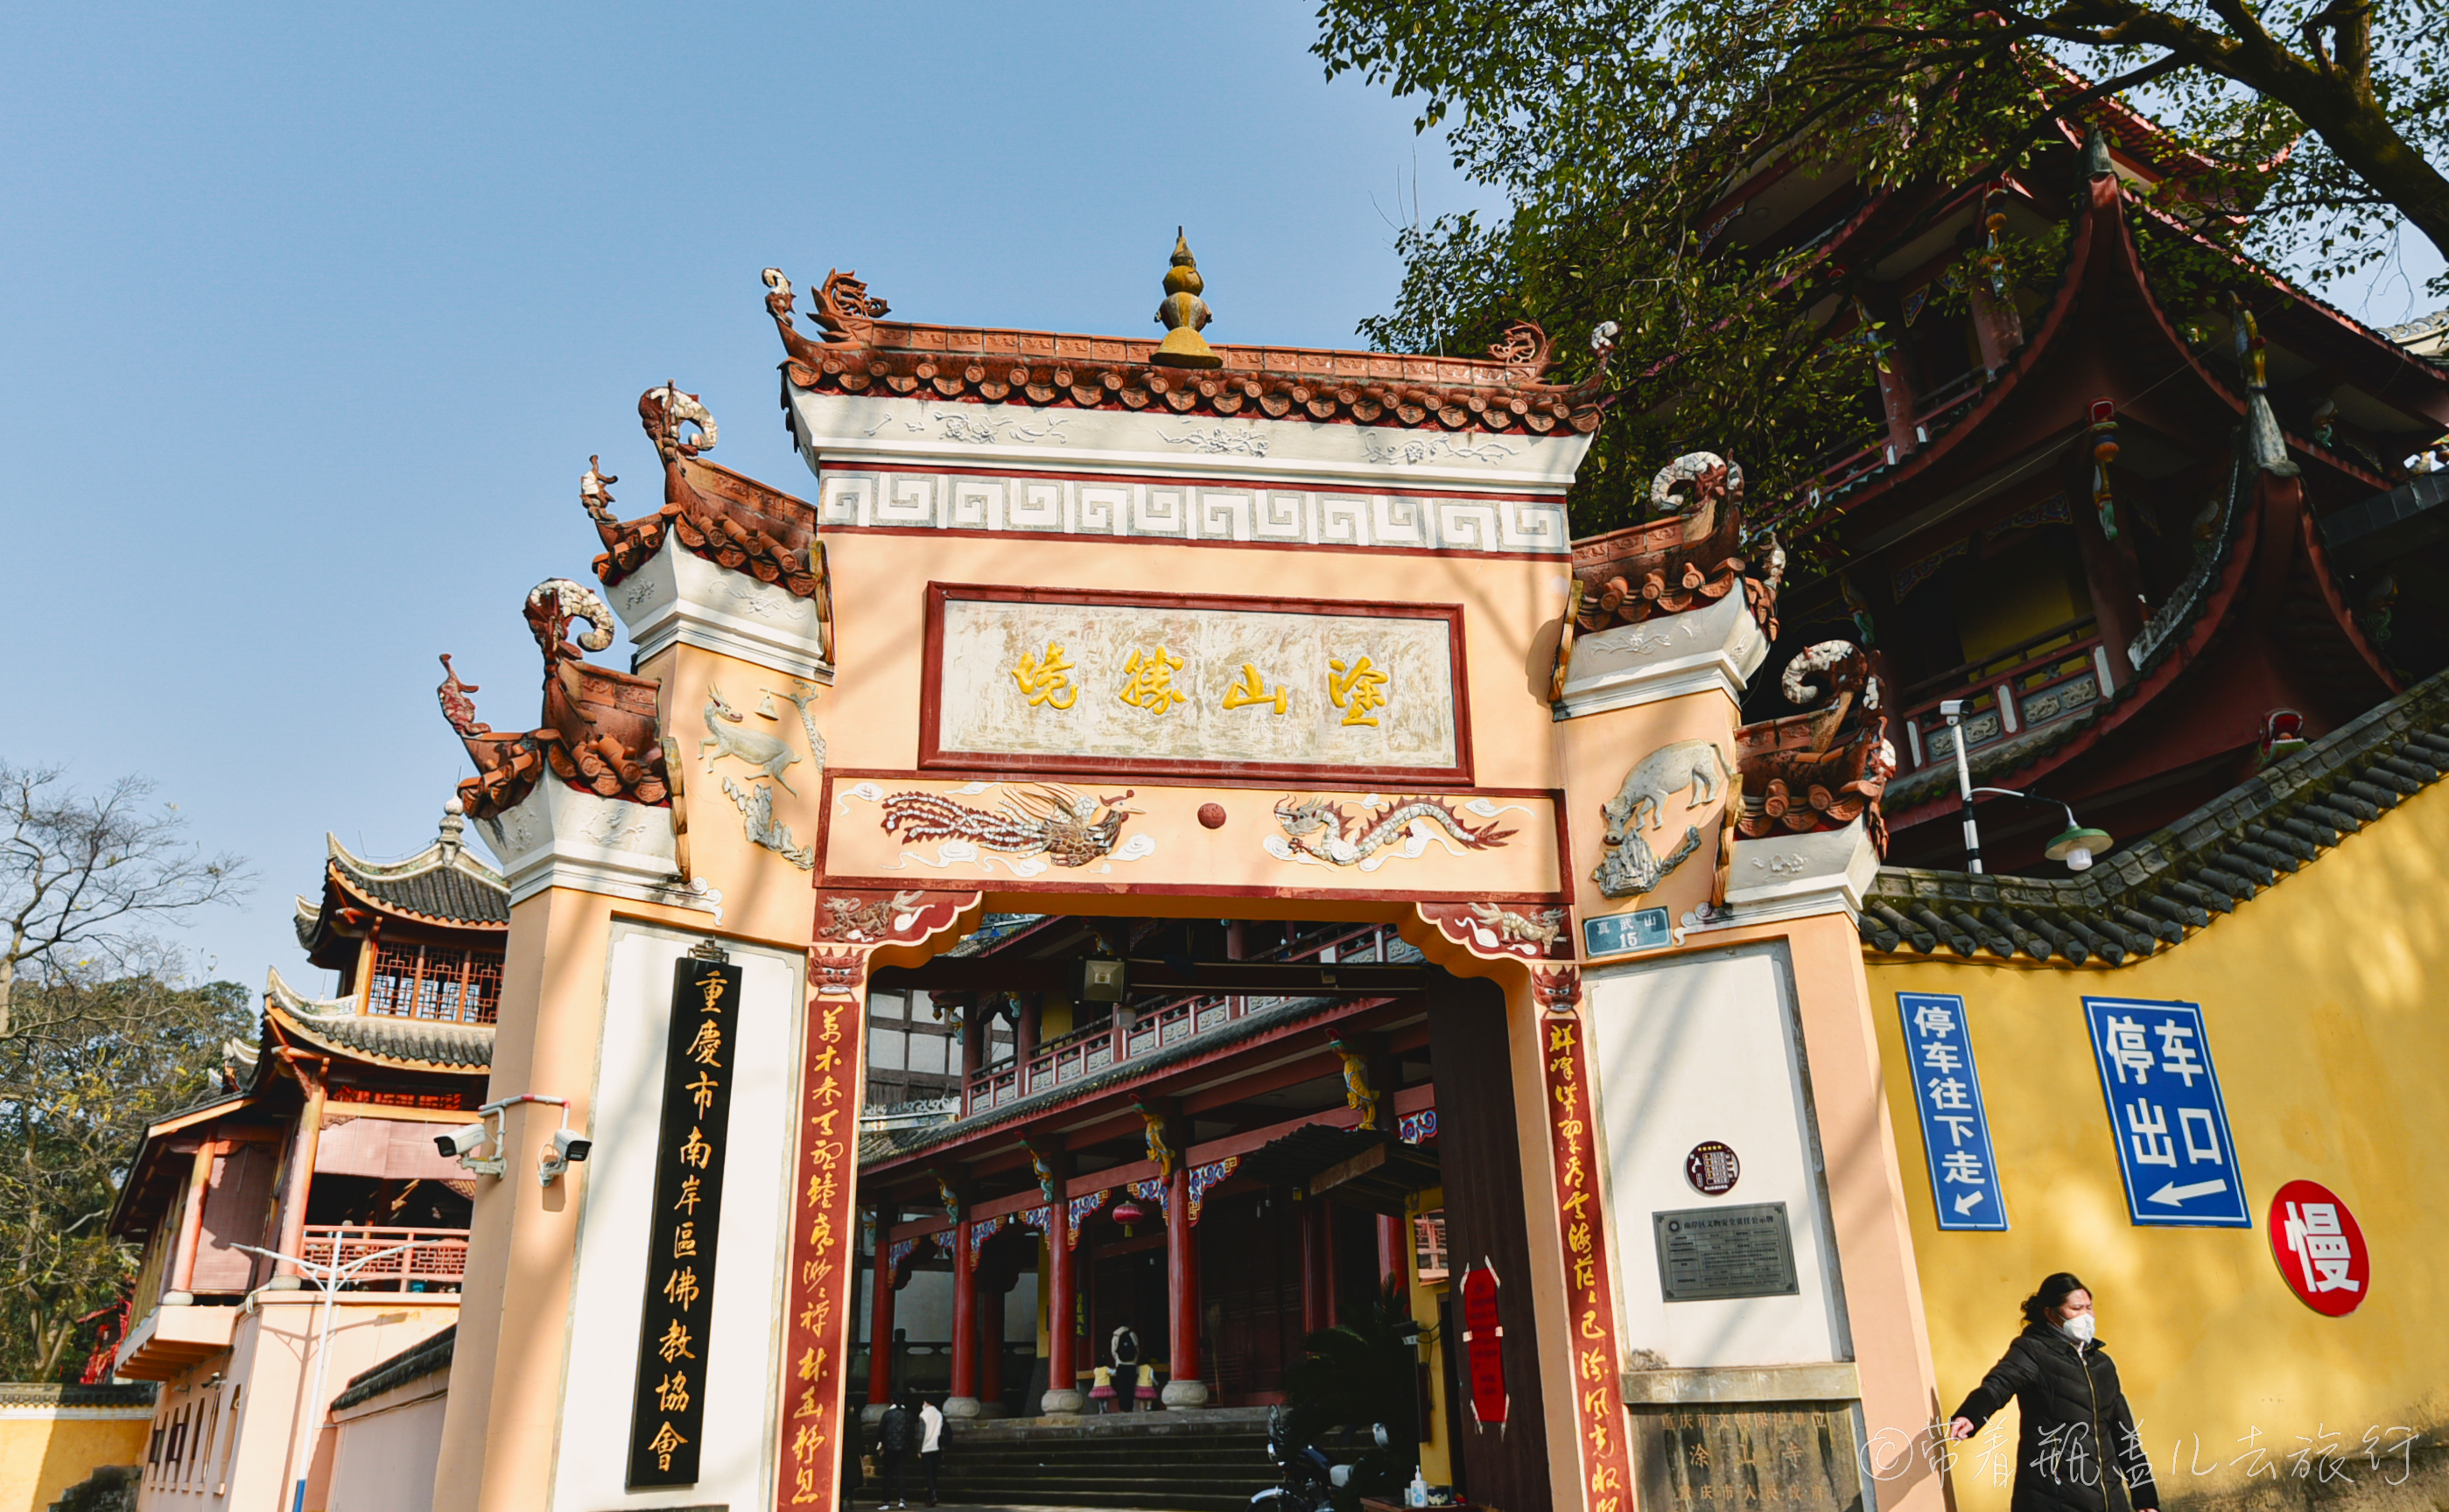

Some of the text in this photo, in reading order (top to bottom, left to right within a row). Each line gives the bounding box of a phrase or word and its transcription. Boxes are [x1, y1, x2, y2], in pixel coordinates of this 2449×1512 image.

[1596, 914, 1657, 935] 真武山
[1619, 932, 1638, 948] 15
[2106, 1015, 2203, 1088] 停车
[1913, 1005, 1986, 1185] 停车往下走
[2125, 1097, 2223, 1169] 出口
[648, 970, 728, 1472] 重慶市南岸區佛教協會
[2284, 1200, 2361, 1293] 慢
[1689, 1442, 1804, 1468] 涂山寺
